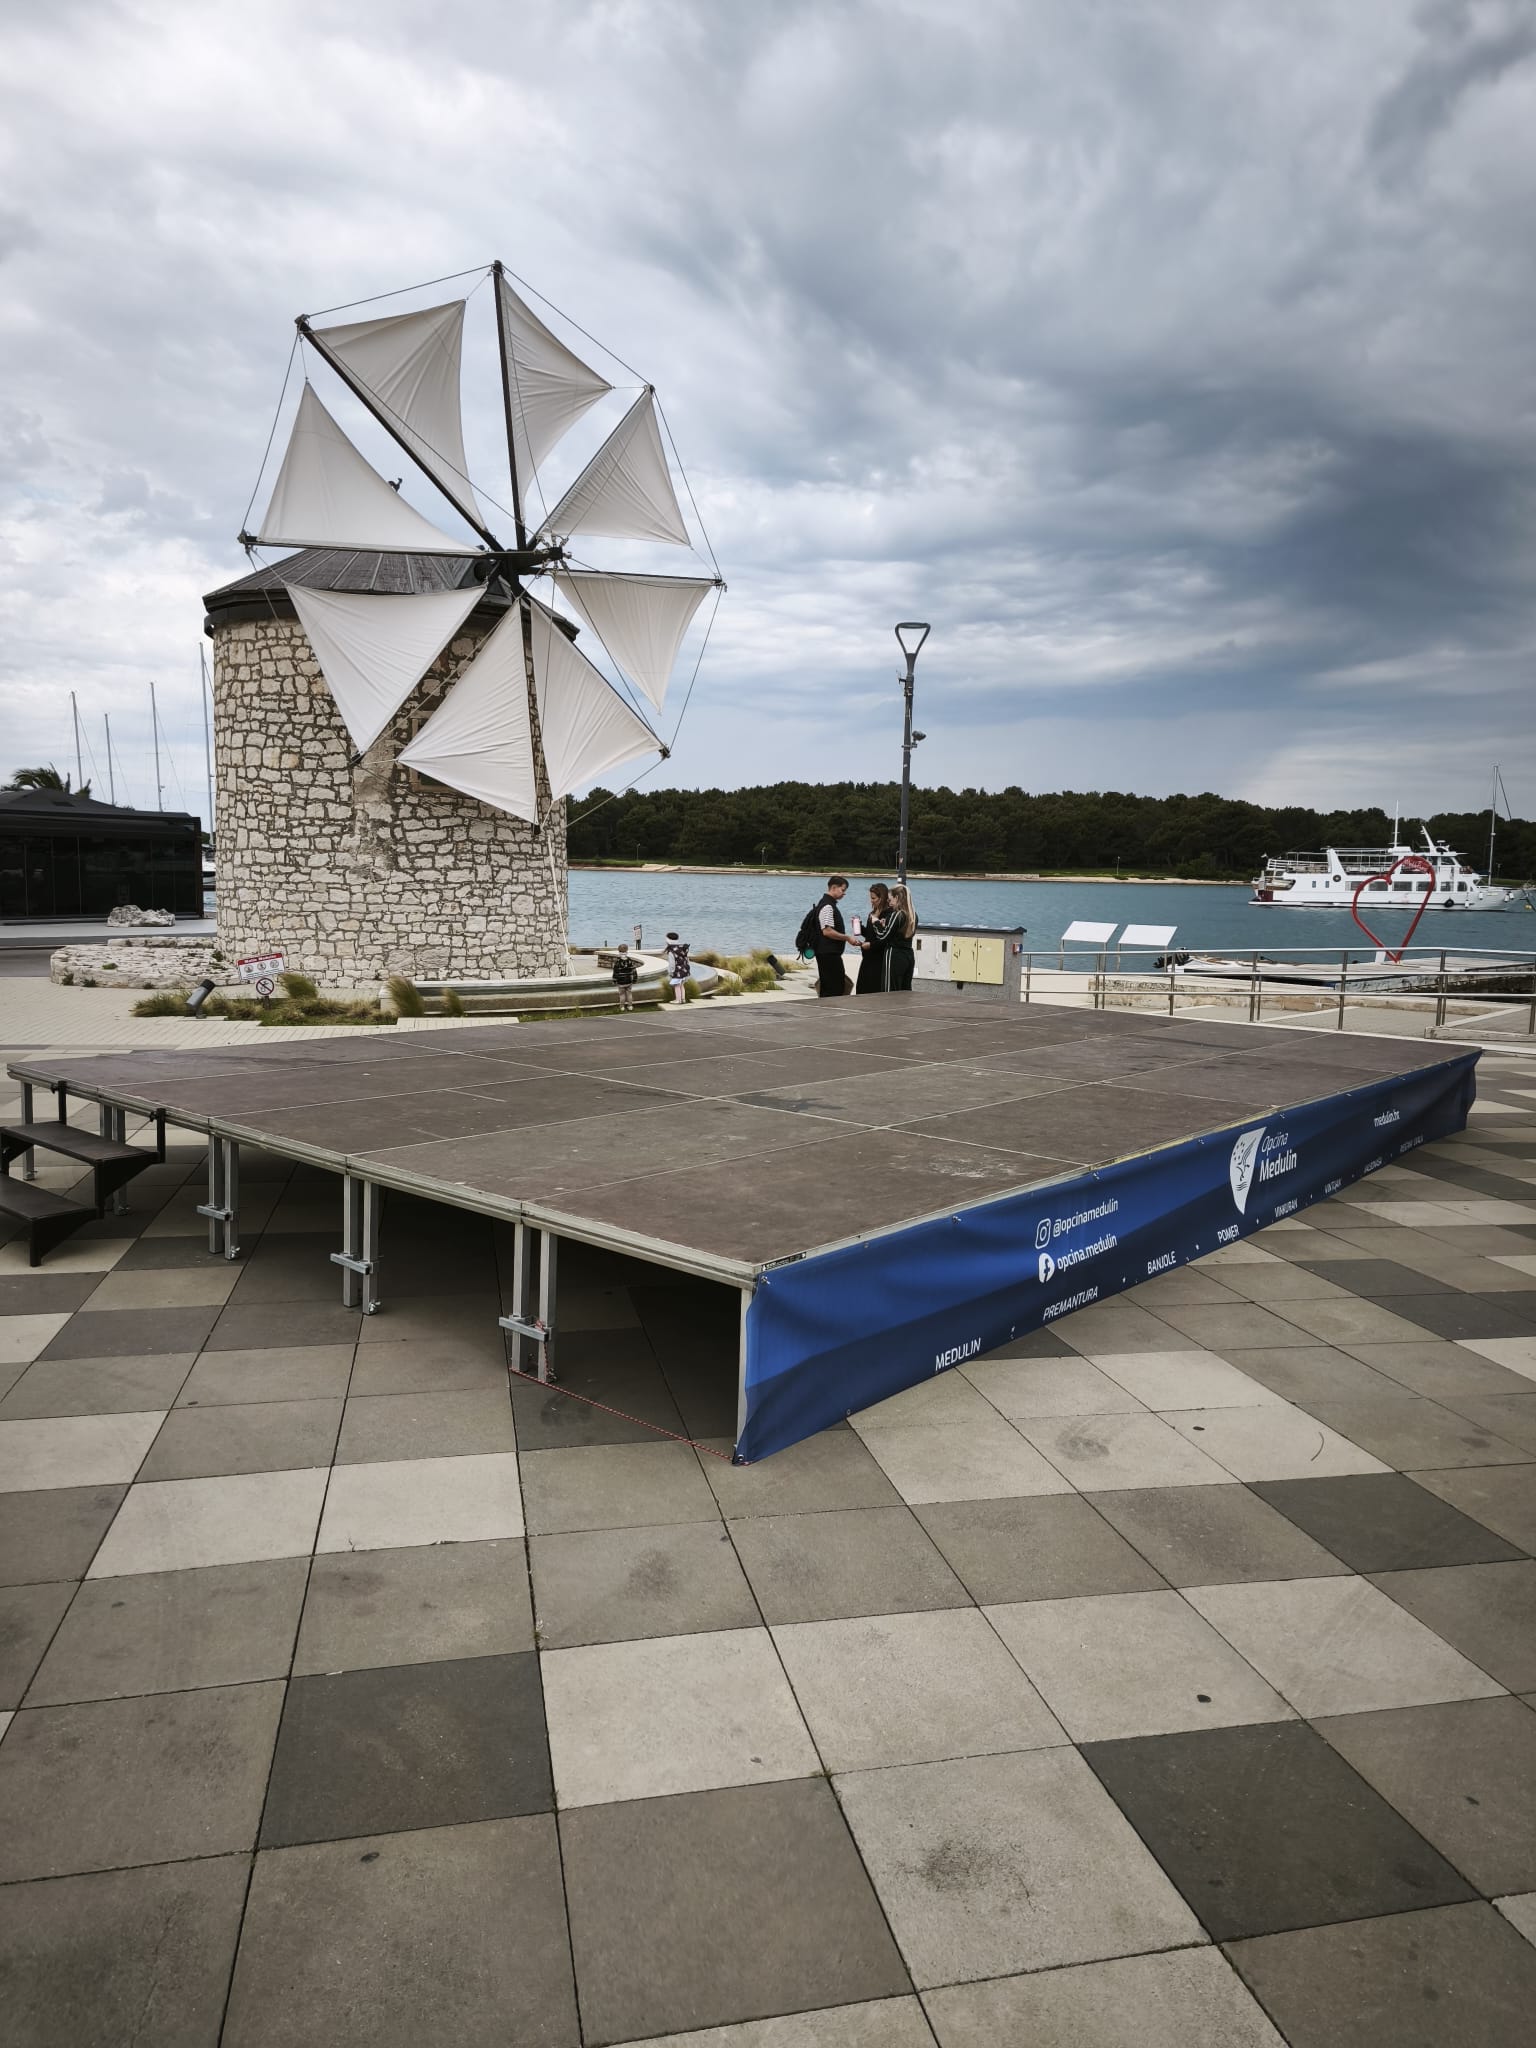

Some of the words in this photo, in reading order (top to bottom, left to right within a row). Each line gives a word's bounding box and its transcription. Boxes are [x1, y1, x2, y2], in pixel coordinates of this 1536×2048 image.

[1259, 1149, 1297, 1182] Medulin
[1053, 1198, 1118, 1237] @opcinamedulin
[1057, 1233, 1117, 1272] opcina.medulin
[935, 1337, 981, 1371] MEDULIN
[1042, 1286, 1098, 1321] PREMANTURA
[1147, 1251, 1176, 1275] BANJOLE
[1217, 1224, 1239, 1243] POMER
